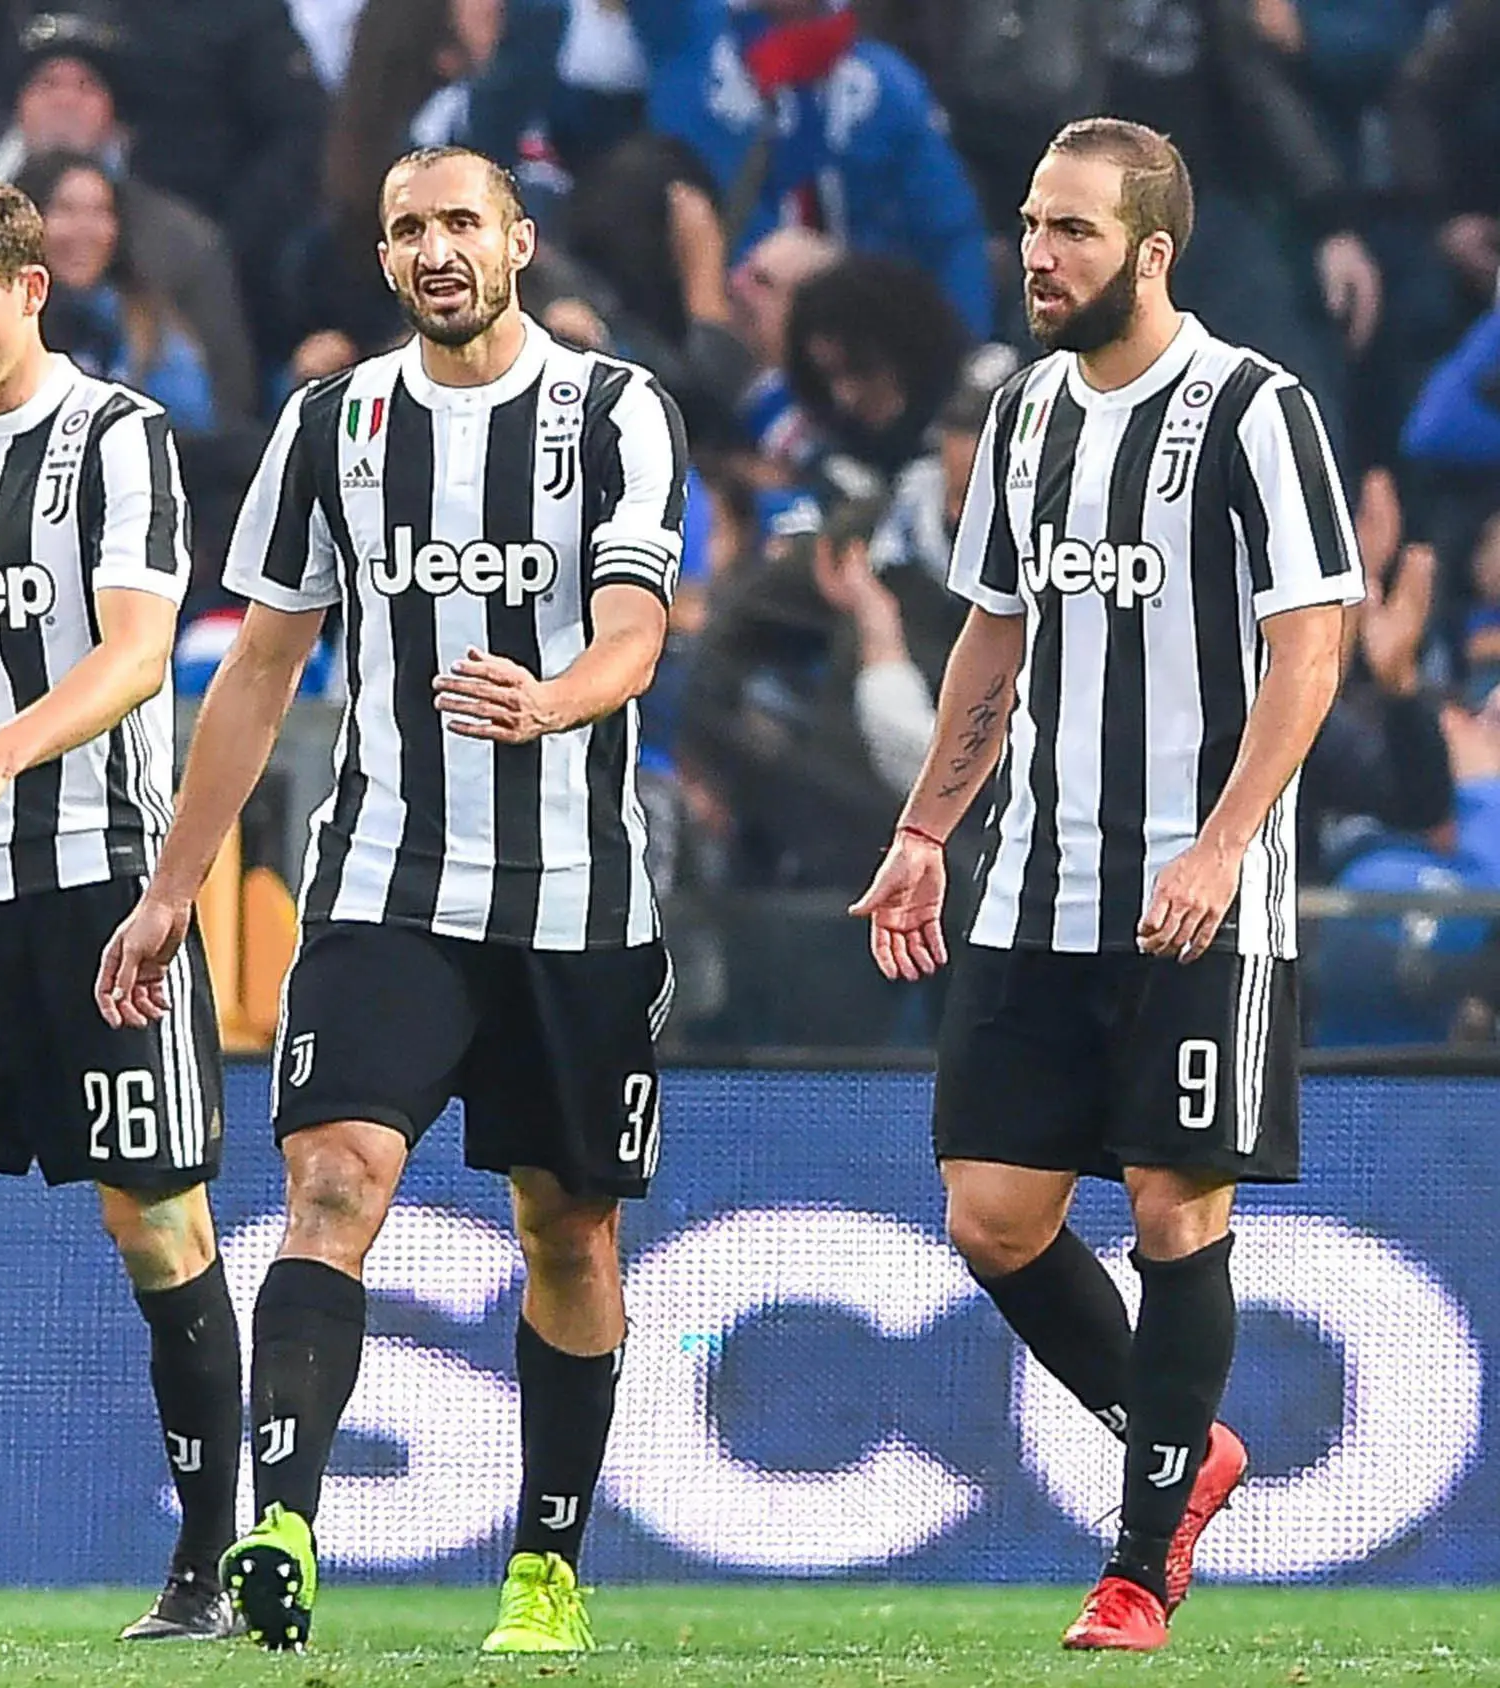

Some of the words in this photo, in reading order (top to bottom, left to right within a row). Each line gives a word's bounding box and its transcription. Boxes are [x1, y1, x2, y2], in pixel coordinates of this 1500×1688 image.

[370, 524, 558, 607] Jeep
[1023, 522, 1165, 609] Jeep
[83, 1069, 158, 1160] 26
[618, 1073, 653, 1162] 3
[1179, 1039, 1218, 1129] 9
